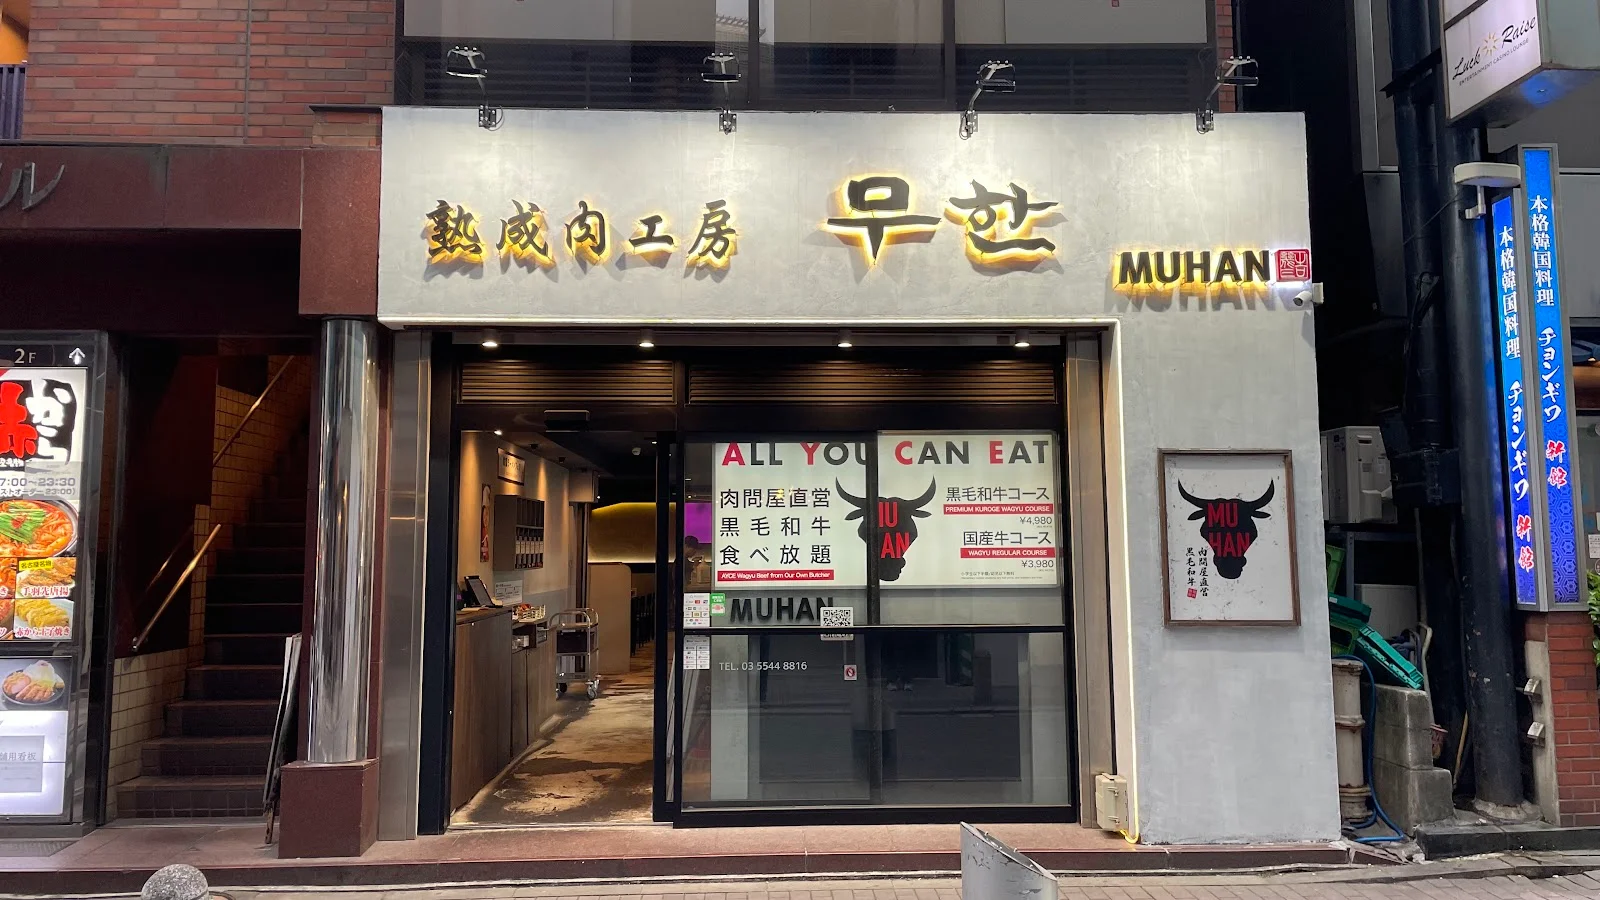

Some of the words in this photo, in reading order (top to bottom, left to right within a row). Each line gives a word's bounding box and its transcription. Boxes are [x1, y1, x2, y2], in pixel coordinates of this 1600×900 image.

[1452, 46, 1480, 80] Luck
[1501, 16, 1536, 48] Raise
[426, 199, 738, 260] 熟成肉工房
[827, 176, 1060, 263] 무한
[1530, 194, 1555, 306] 本格韓国料理
[1118, 249, 1271, 285] MUHAN
[1499, 225, 1521, 359] 本格韓国料理
[14, 348, 37, 364] 2F
[1538, 327, 1563, 423] チョンギワ
[722, 442, 783, 466] ALL
[895, 440, 970, 465] CAN
[989, 440, 1049, 464] EAT
[1508, 381, 1530, 501] チョンギワ
[720, 487, 831, 508] 肉問屋直営
[946, 486, 1050, 502] 黒毛和牛コース
[719, 516, 831, 537] 黒毛和牛
[1019, 516, 1053, 526] ¥4,980
[1207, 502, 1239, 528] MU
[963, 531, 1052, 546] 国産牛コース
[1208, 532, 1250, 558] HAN
[719, 544, 831, 565] 食べ放題
[1021, 560, 1054, 569] ¥3,980
[1185, 547, 1196, 587] 黒毛和牛
[737, 572, 756, 580] Wagyu
[729, 595, 835, 623] MUHAN
[719, 662, 739, 671] TEL.
[741, 662, 754, 671] 03
[756, 662, 781, 670] 5544
[782, 661, 808, 670] 8816
